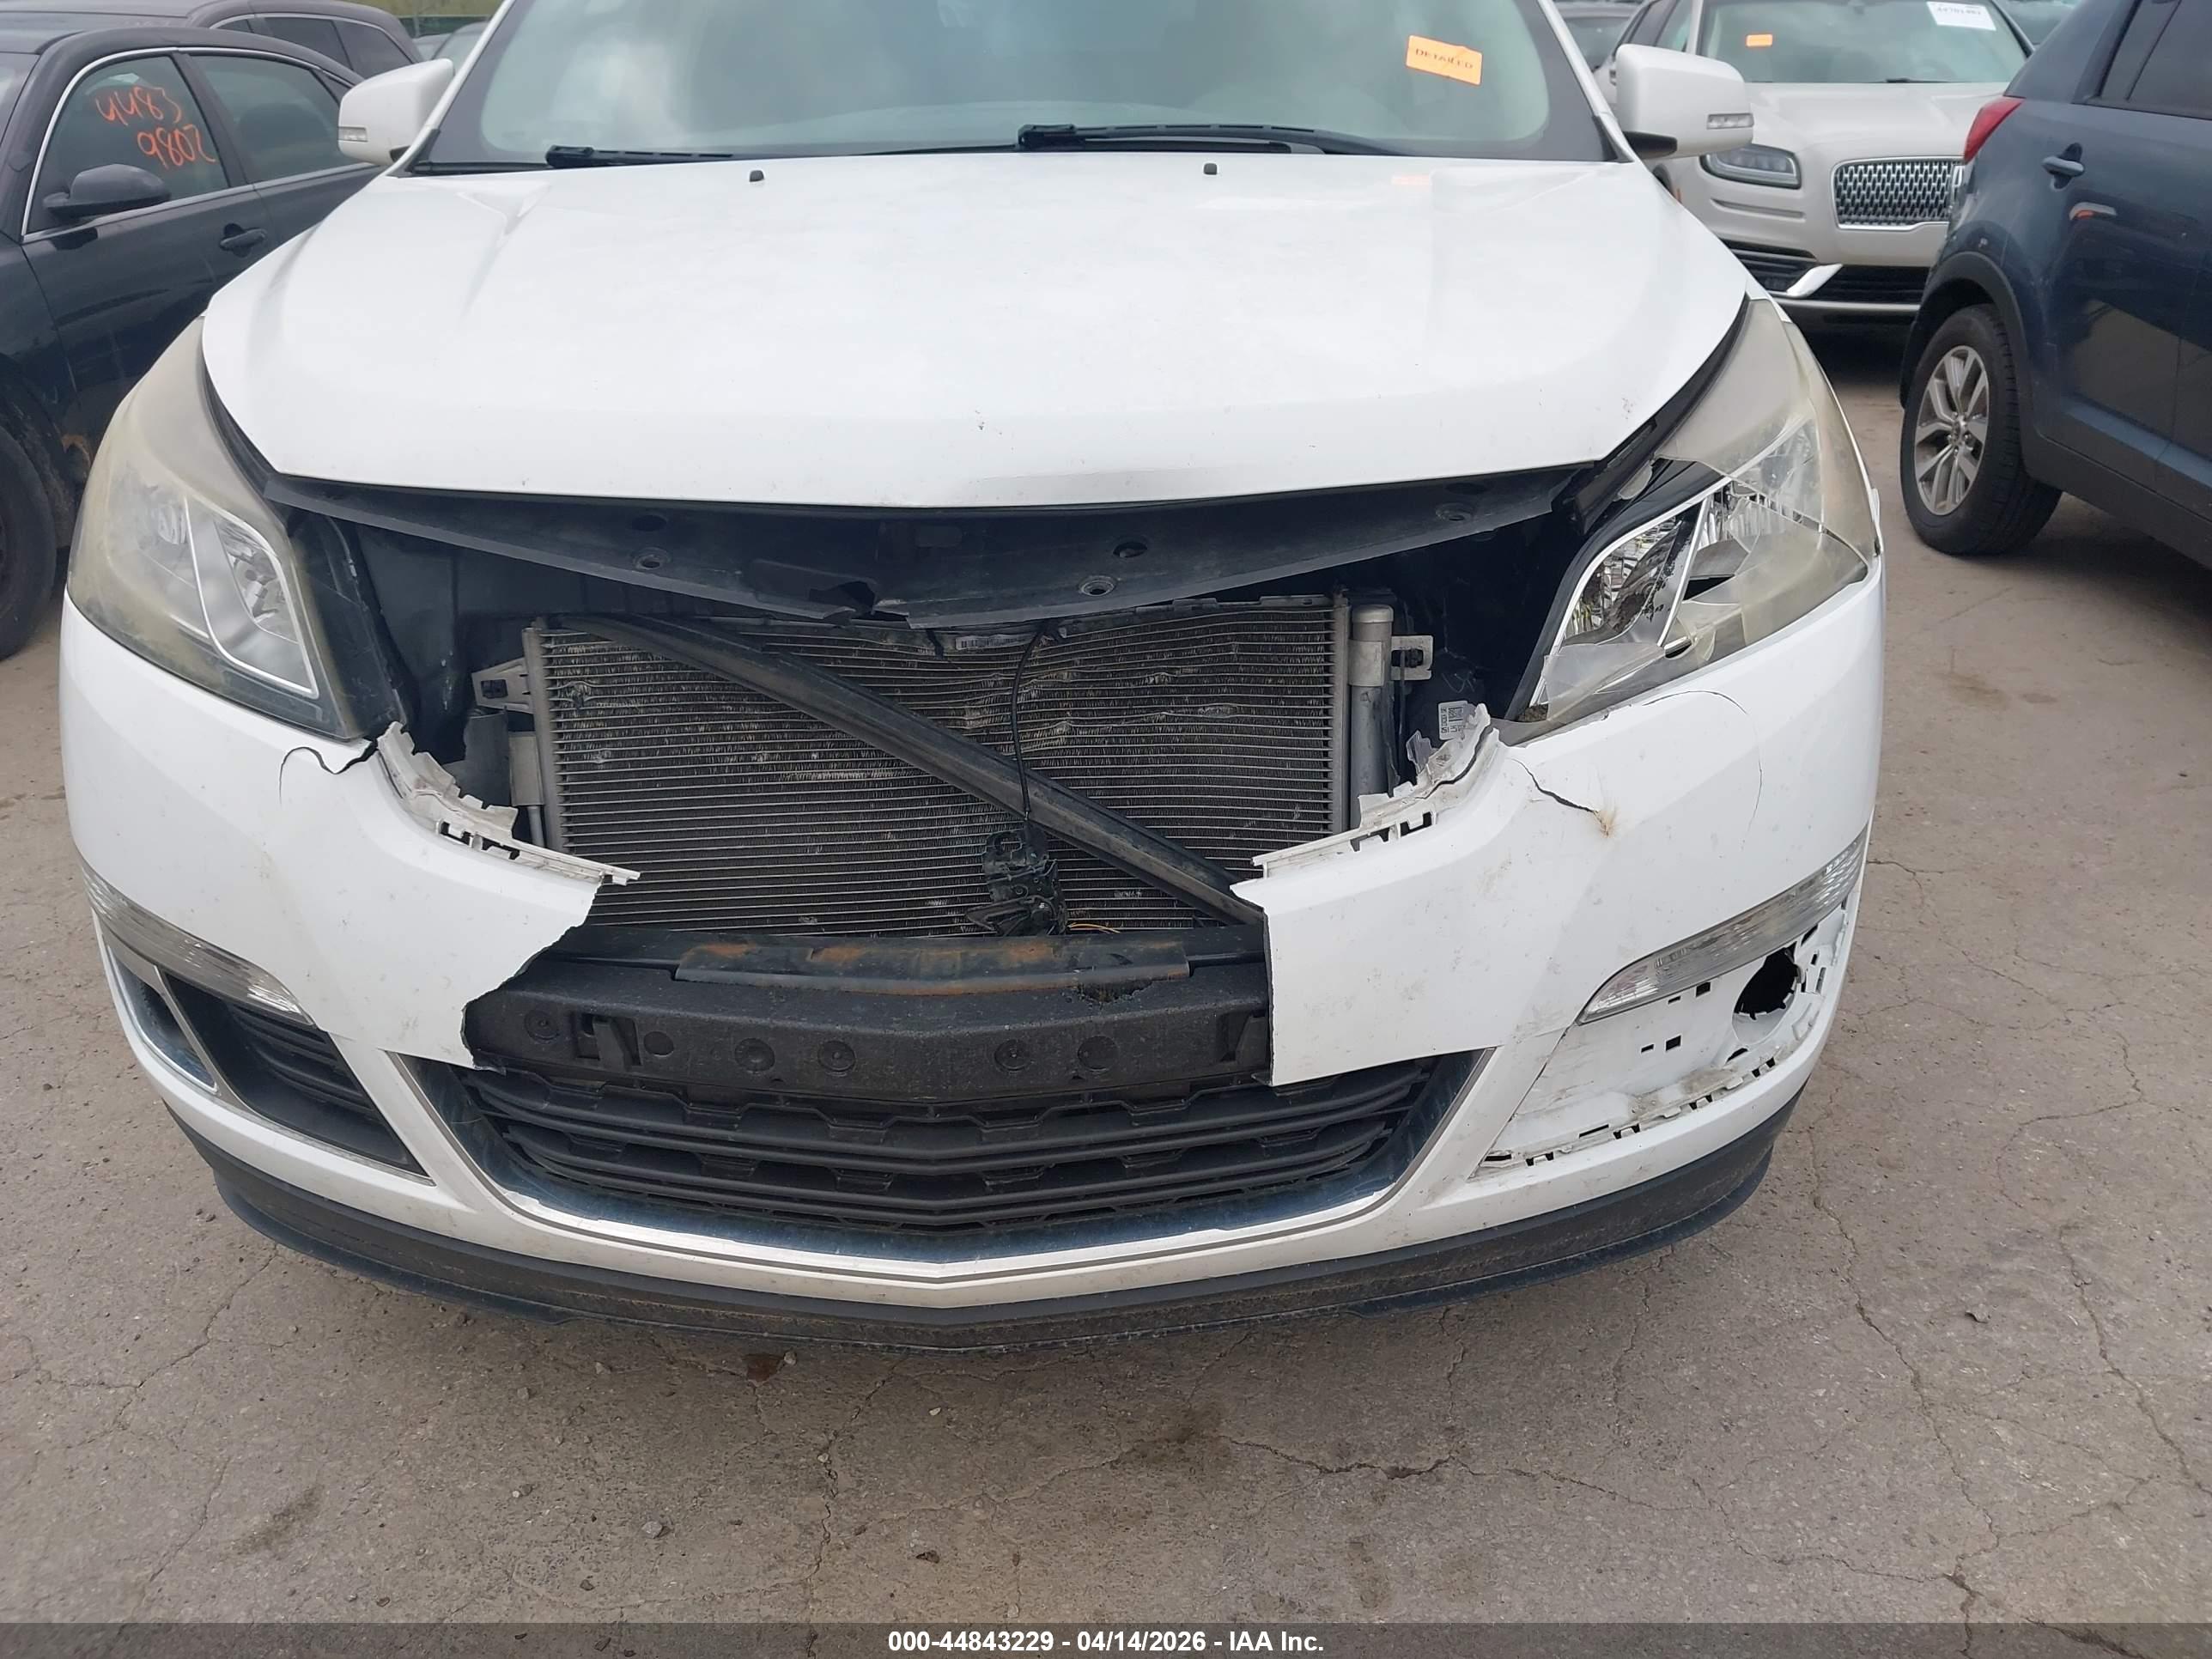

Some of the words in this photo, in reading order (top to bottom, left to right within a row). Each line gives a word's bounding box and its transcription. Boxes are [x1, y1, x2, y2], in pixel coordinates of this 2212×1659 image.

[1415, 48, 1474, 69] DETAILED
[95, 86, 182, 126] 4483
[137, 124, 216, 169] 9802
